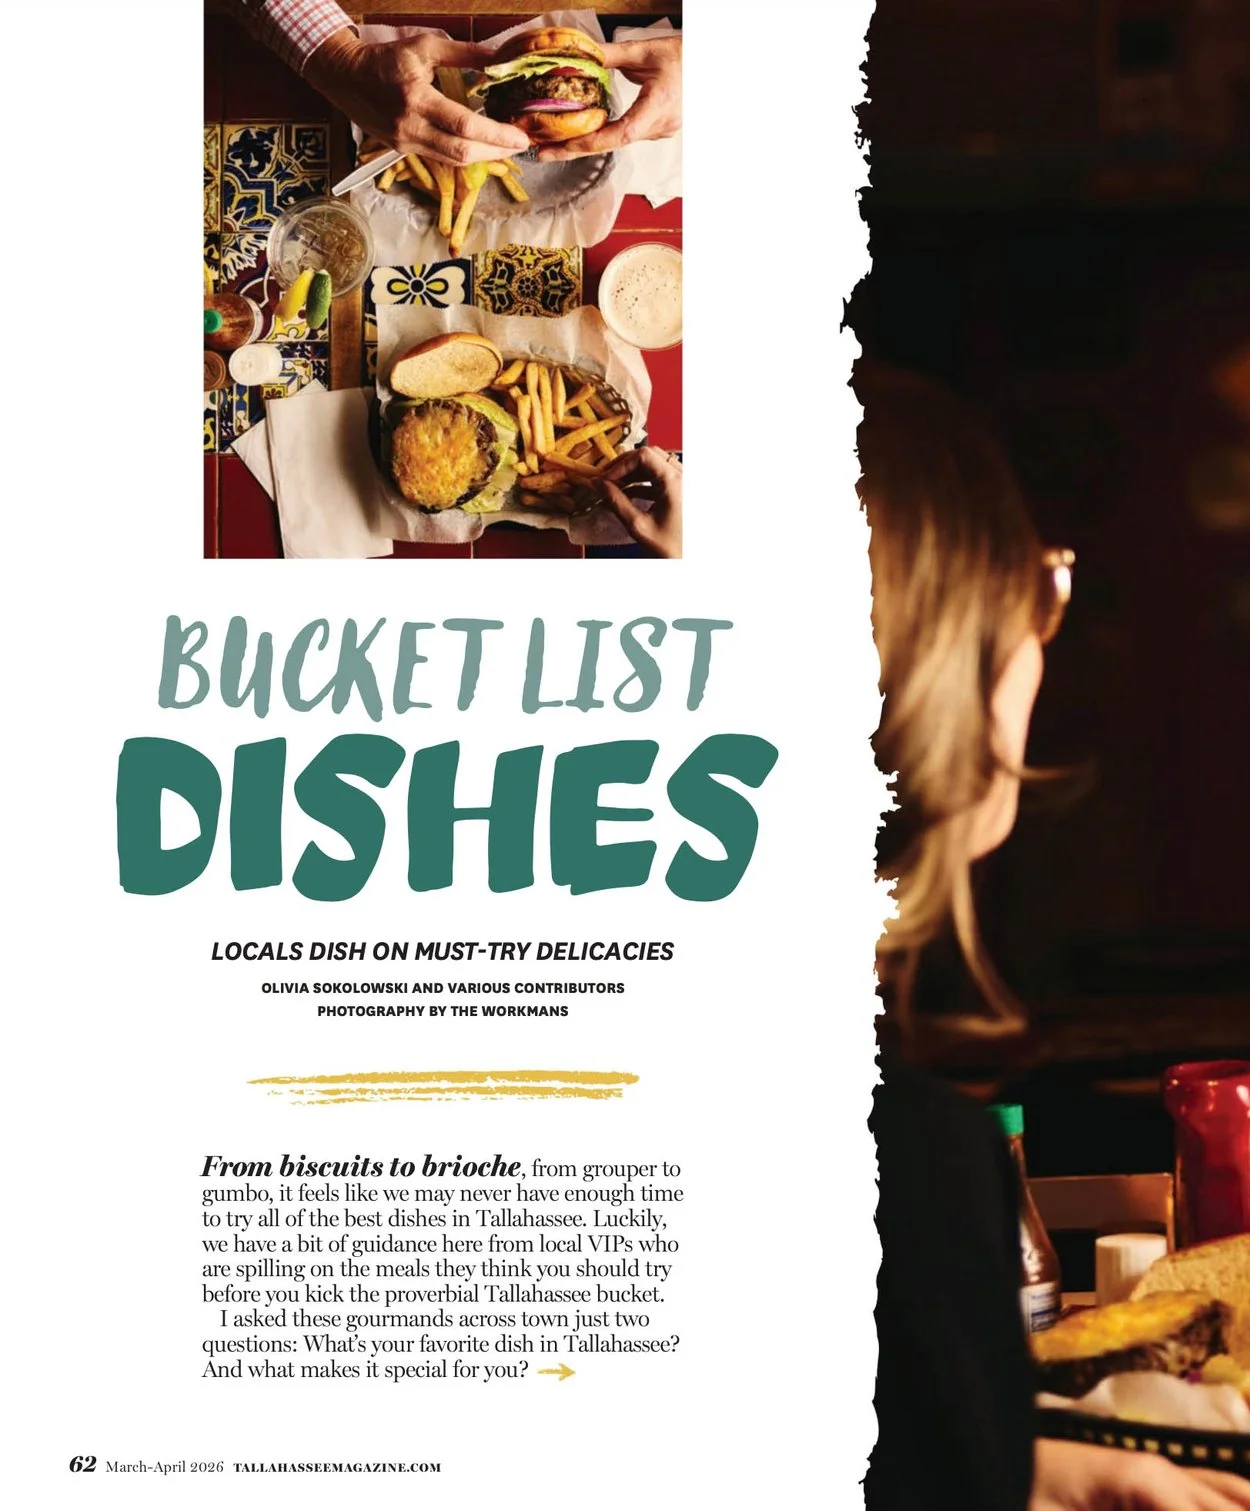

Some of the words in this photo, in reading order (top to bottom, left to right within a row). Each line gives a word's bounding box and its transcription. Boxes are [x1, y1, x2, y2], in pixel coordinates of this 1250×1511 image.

[158, 614, 505, 723] BUCKET
[521, 616, 734, 715] LIST
[115, 733, 780, 903] DISHES
[211, 941, 304, 961] LOCALS
[308, 941, 367, 961] DISH
[372, 941, 410, 961] ON
[414, 941, 533, 961] MUST-TRY
[535, 941, 675, 961] DELICACIES
[261, 982, 310, 994] OLIVIA
[312, 982, 408, 994] SOKOLOWSKI
[411, 982, 444, 994] AND
[447, 982, 511, 994] VARIOUS
[514, 982, 625, 994] CONTRIBUTORS
[317, 1005, 426, 1017] PHOTOGRAPHY
[429, 1005, 448, 1017] BY
[450, 1005, 478, 1017] THE
[481, 1005, 569, 1017] WORKMANS
[199, 1155, 274, 1178] From
[279, 1153, 384, 1178] biscuits
[389, 1157, 416, 1178] to
[421, 1153, 526, 1181] brioche,
[531, 1157, 578, 1177] from
[582, 1164, 658, 1183] grouper
[661, 1161, 681, 1177] to
[201, 1211, 222, 1227] to
[225, 1211, 254, 1233] try
[258, 1207, 280, 1227] all
[285, 1207, 307, 1227] of
[308, 1207, 340, 1228] the
[344, 1207, 383, 1228] best
[388, 1207, 447, 1228] dishes
[452, 1209, 471, 1227] in
[475, 1207, 587, 1228] Tallahassee.
[593, 1207, 667, 1233] Luckily,
[202, 1264, 231, 1278] are
[235, 1258, 306, 1283] spilling
[310, 1264, 335, 1277] on
[339, 1258, 371, 1277] the
[375, 1257, 430, 1278] meals
[434, 1258, 477, 1283] they
[480, 1258, 533, 1277] think
[535, 1264, 571, 1283] you
[576, 1257, 640, 1278] should
[645, 1261, 673, 1283] try
[201, 1283, 261, 1303] before
[264, 1290, 300, 1308] you
[304, 1283, 345, 1303] kick
[348, 1283, 380, 1303] the
[384, 1283, 479, 1308] proverbial
[483, 1283, 591, 1303] Tallahassee
[596, 1283, 665, 1303] bucket.
[202, 1334, 297, 1358] questions:
[370, 1340, 415, 1358] your
[419, 1333, 490, 1353] favorite
[494, 1333, 535, 1353] dish
[539, 1334, 559, 1353] in
[563, 1333, 680, 1353] Tallahassee?
[201, 1358, 243, 1378] And
[247, 1358, 296, 1378] what
[300, 1358, 361, 1378] makes
[365, 1359, 380, 1378] it
[384, 1358, 448, 1383] special
[452, 1358, 481, 1379] for
[482, 1358, 529, 1384] you?
[69, 1455, 97, 1473] 62
[106, 1460, 186, 1476] March-April
[190, 1460, 224, 1473] 2026
[232, 1462, 441, 1473] TALLAHASSEEMAGAZINE.COM
